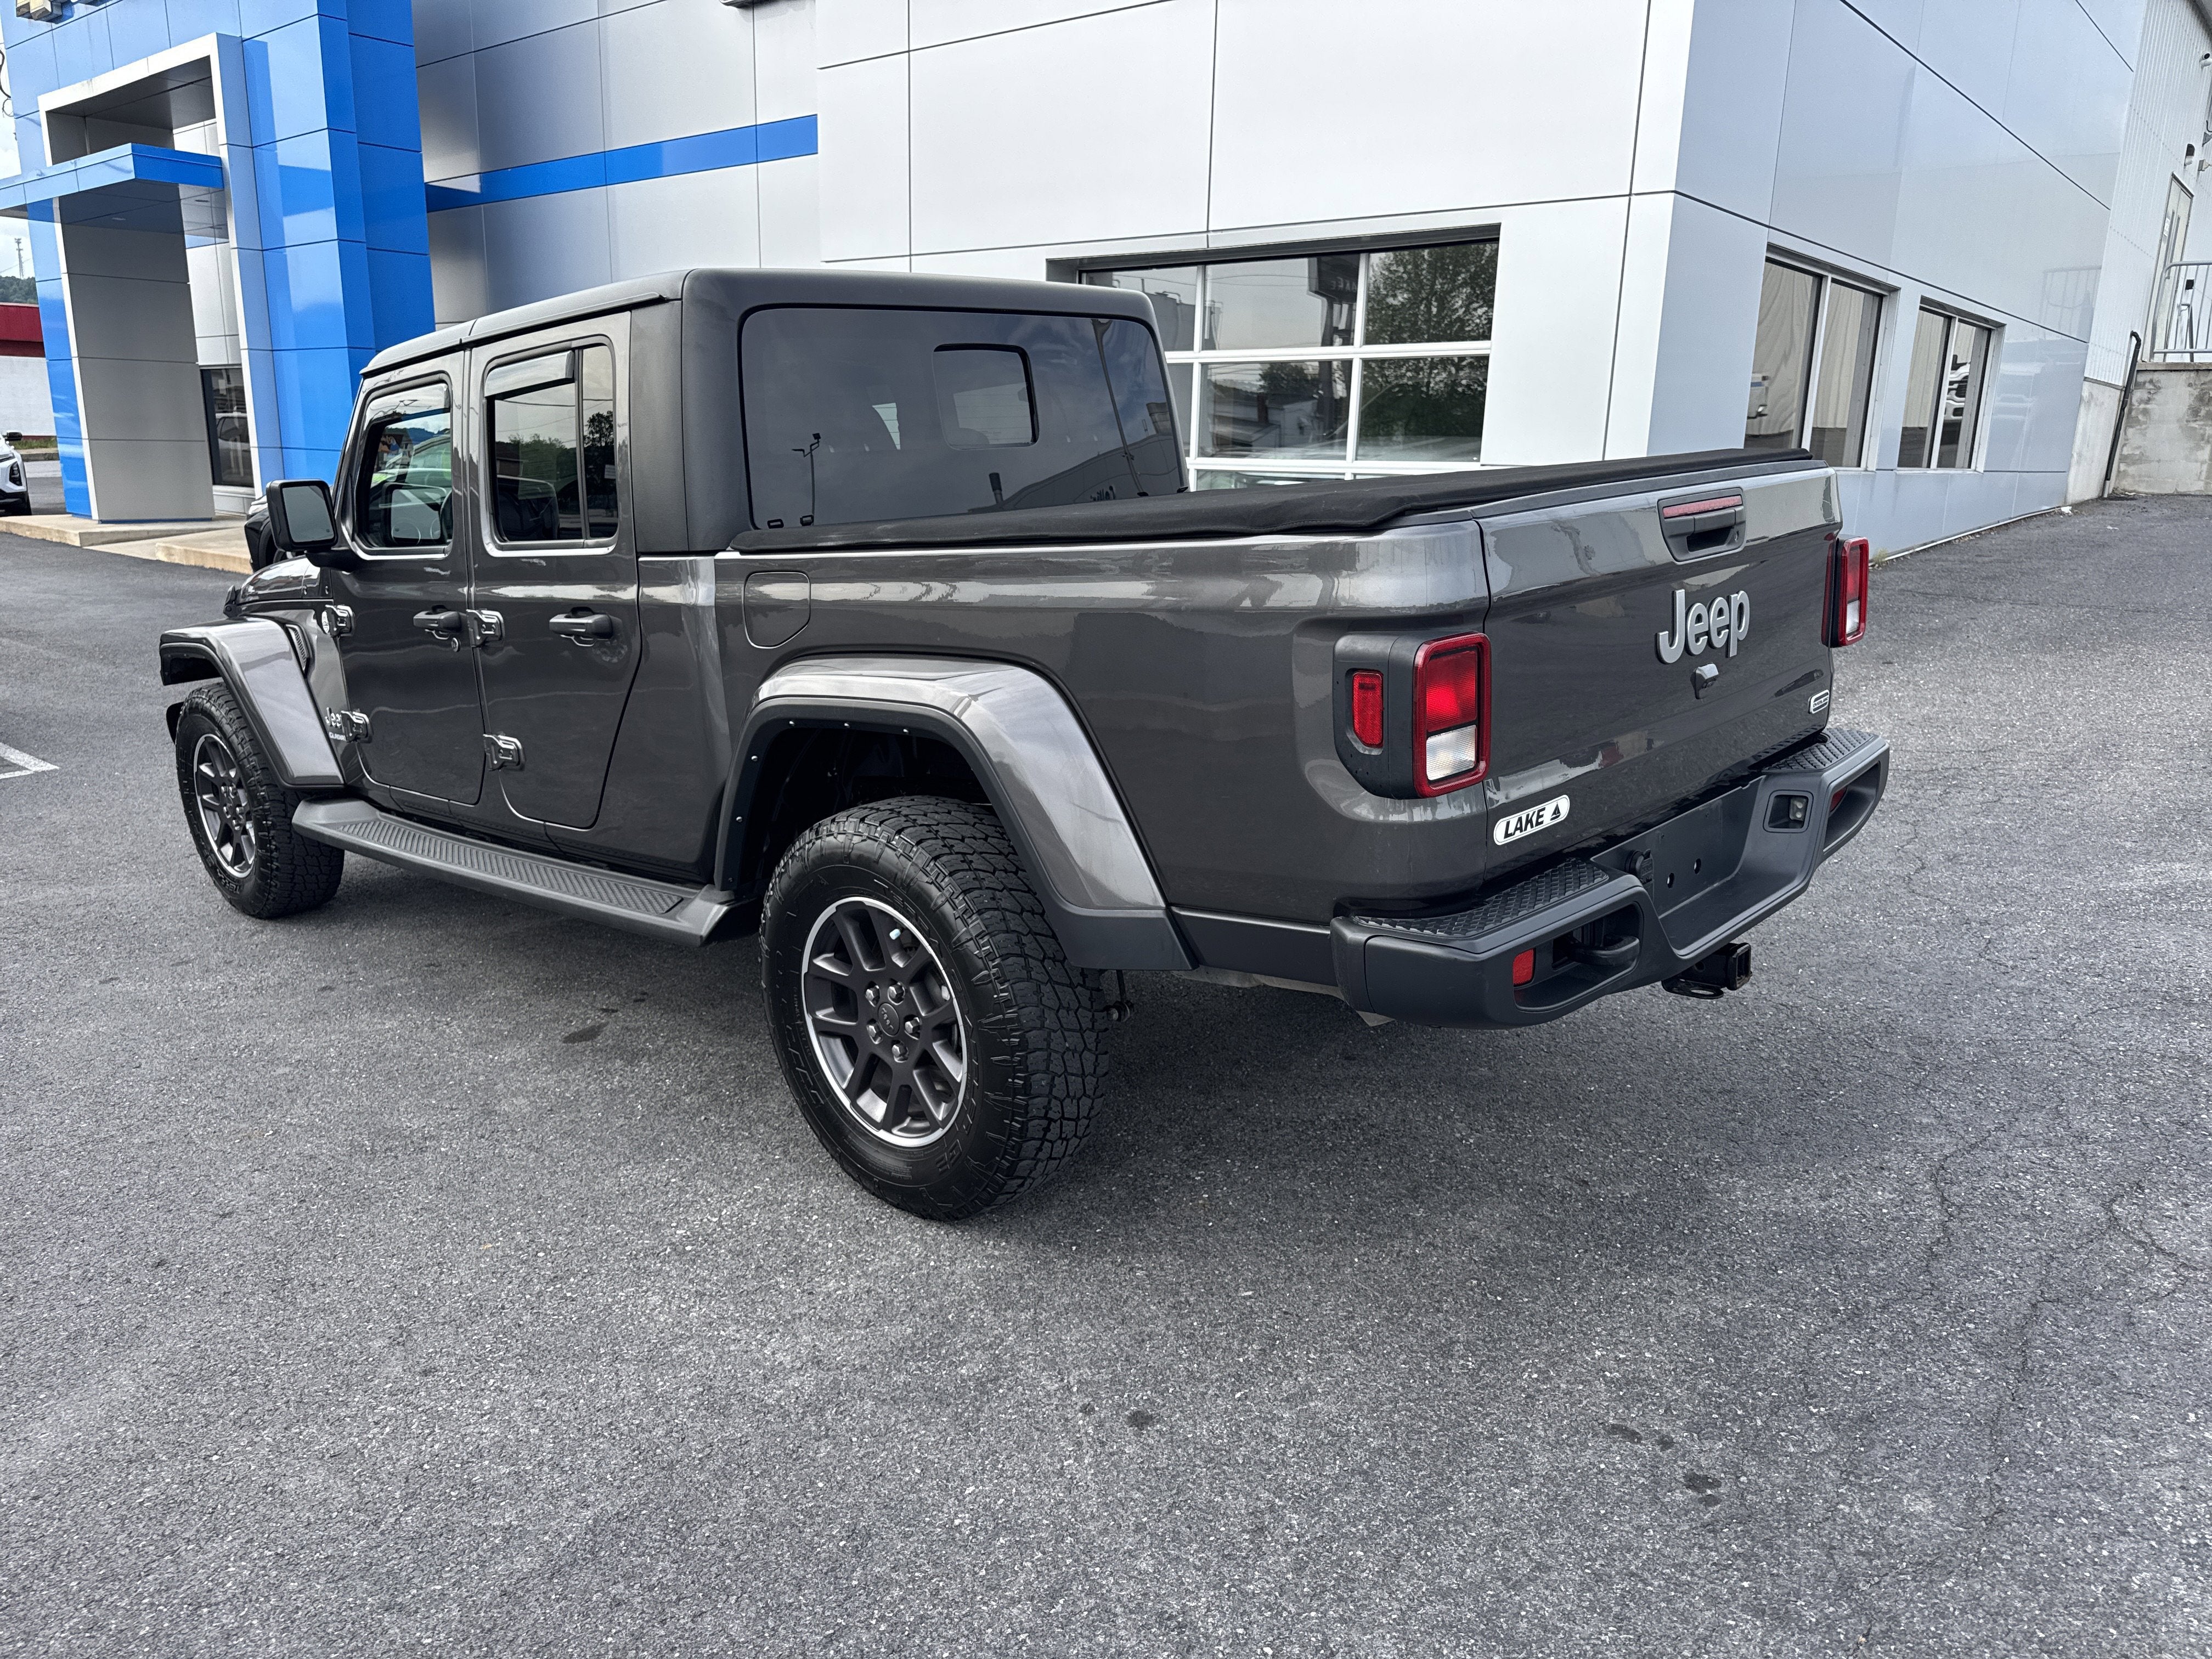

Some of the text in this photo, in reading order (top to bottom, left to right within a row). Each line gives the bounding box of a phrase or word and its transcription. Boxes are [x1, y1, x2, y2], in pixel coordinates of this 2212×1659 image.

[1657, 589, 1750, 664] Jeep
[325, 707, 342, 727] Jee
[1504, 807, 1545, 839] LAKE
